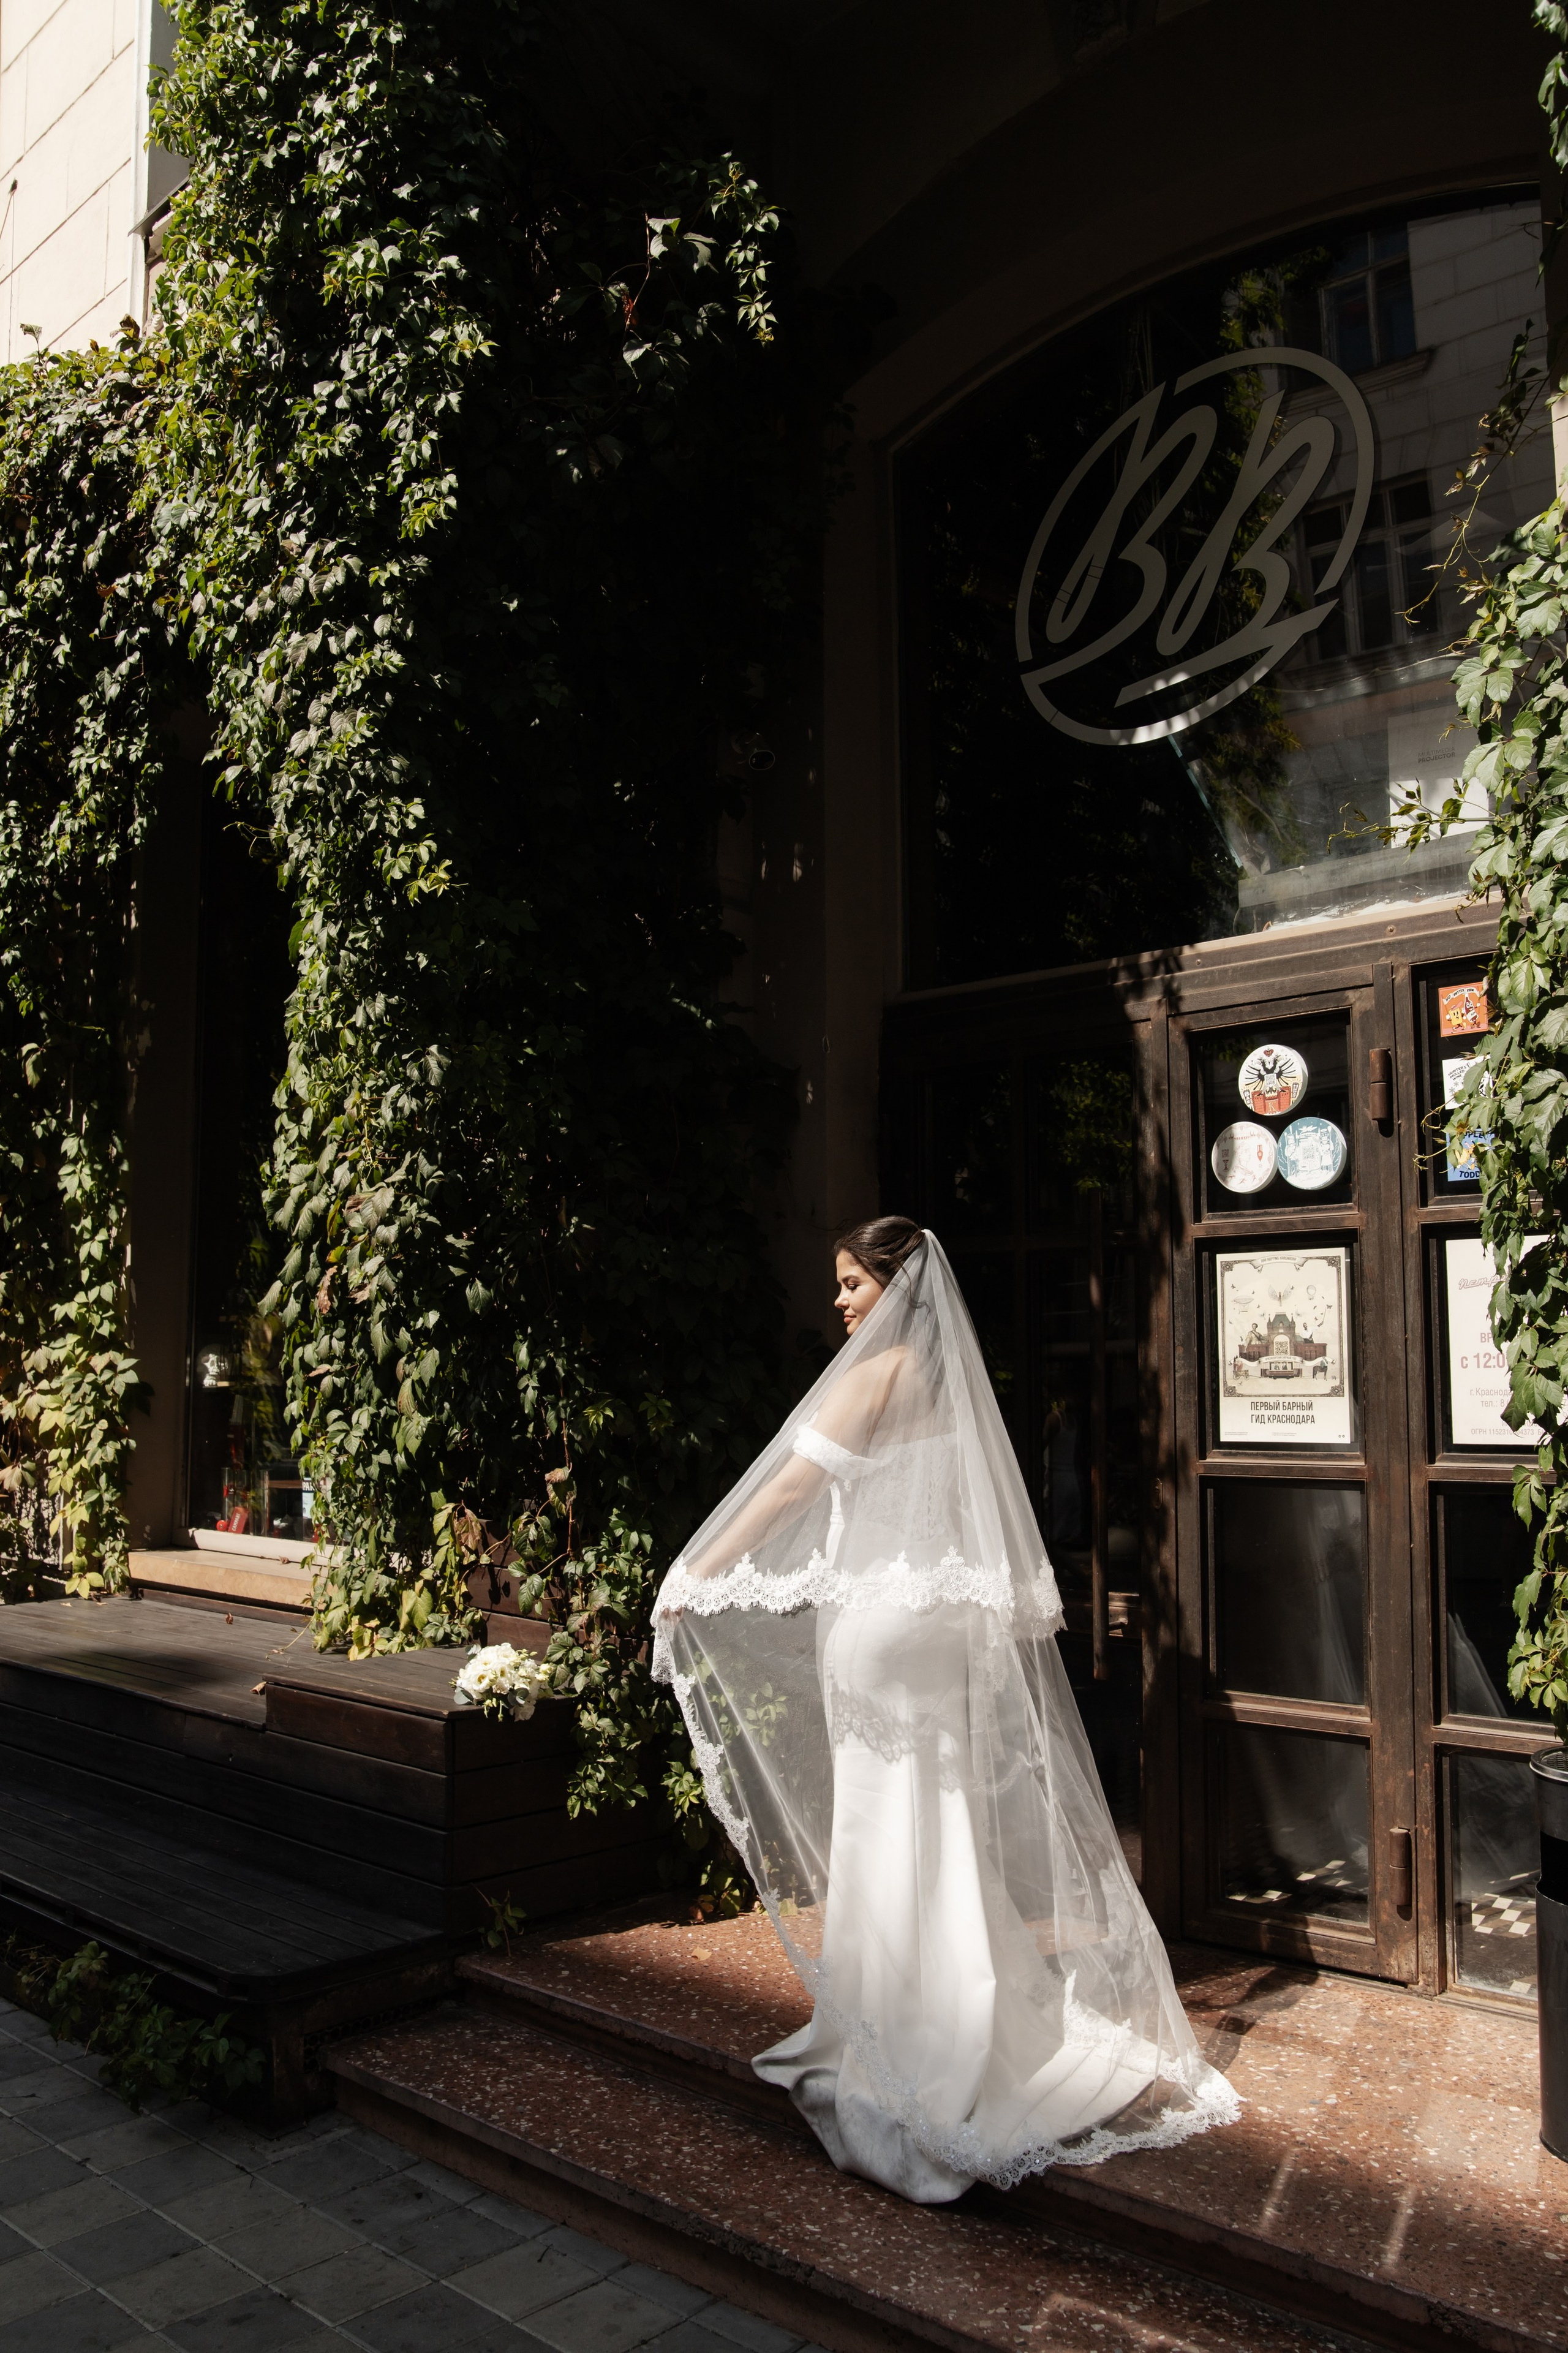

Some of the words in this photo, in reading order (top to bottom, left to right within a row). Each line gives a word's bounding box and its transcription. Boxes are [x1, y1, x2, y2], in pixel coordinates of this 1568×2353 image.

[1417, 746, 1455, 757] MULTIMEDIA
[1418, 752, 1455, 763] PROJECTOR
[1450, 1069, 1465, 1079] MULLED
[1473, 1352, 1506, 1369] 12:0
[1476, 1388, 1512, 1397] Краснода
[1250, 1400, 1280, 1411] ПЕРВЫЙ
[1282, 1400, 1313, 1411] БАРНЫЙ
[1500, 1399, 1505, 1408] 8
[1251, 1414, 1265, 1424] ГИД
[1267, 1414, 1316, 1425] КРАСНОДАРА
[232, 1513, 241, 1532] CAMPARI
